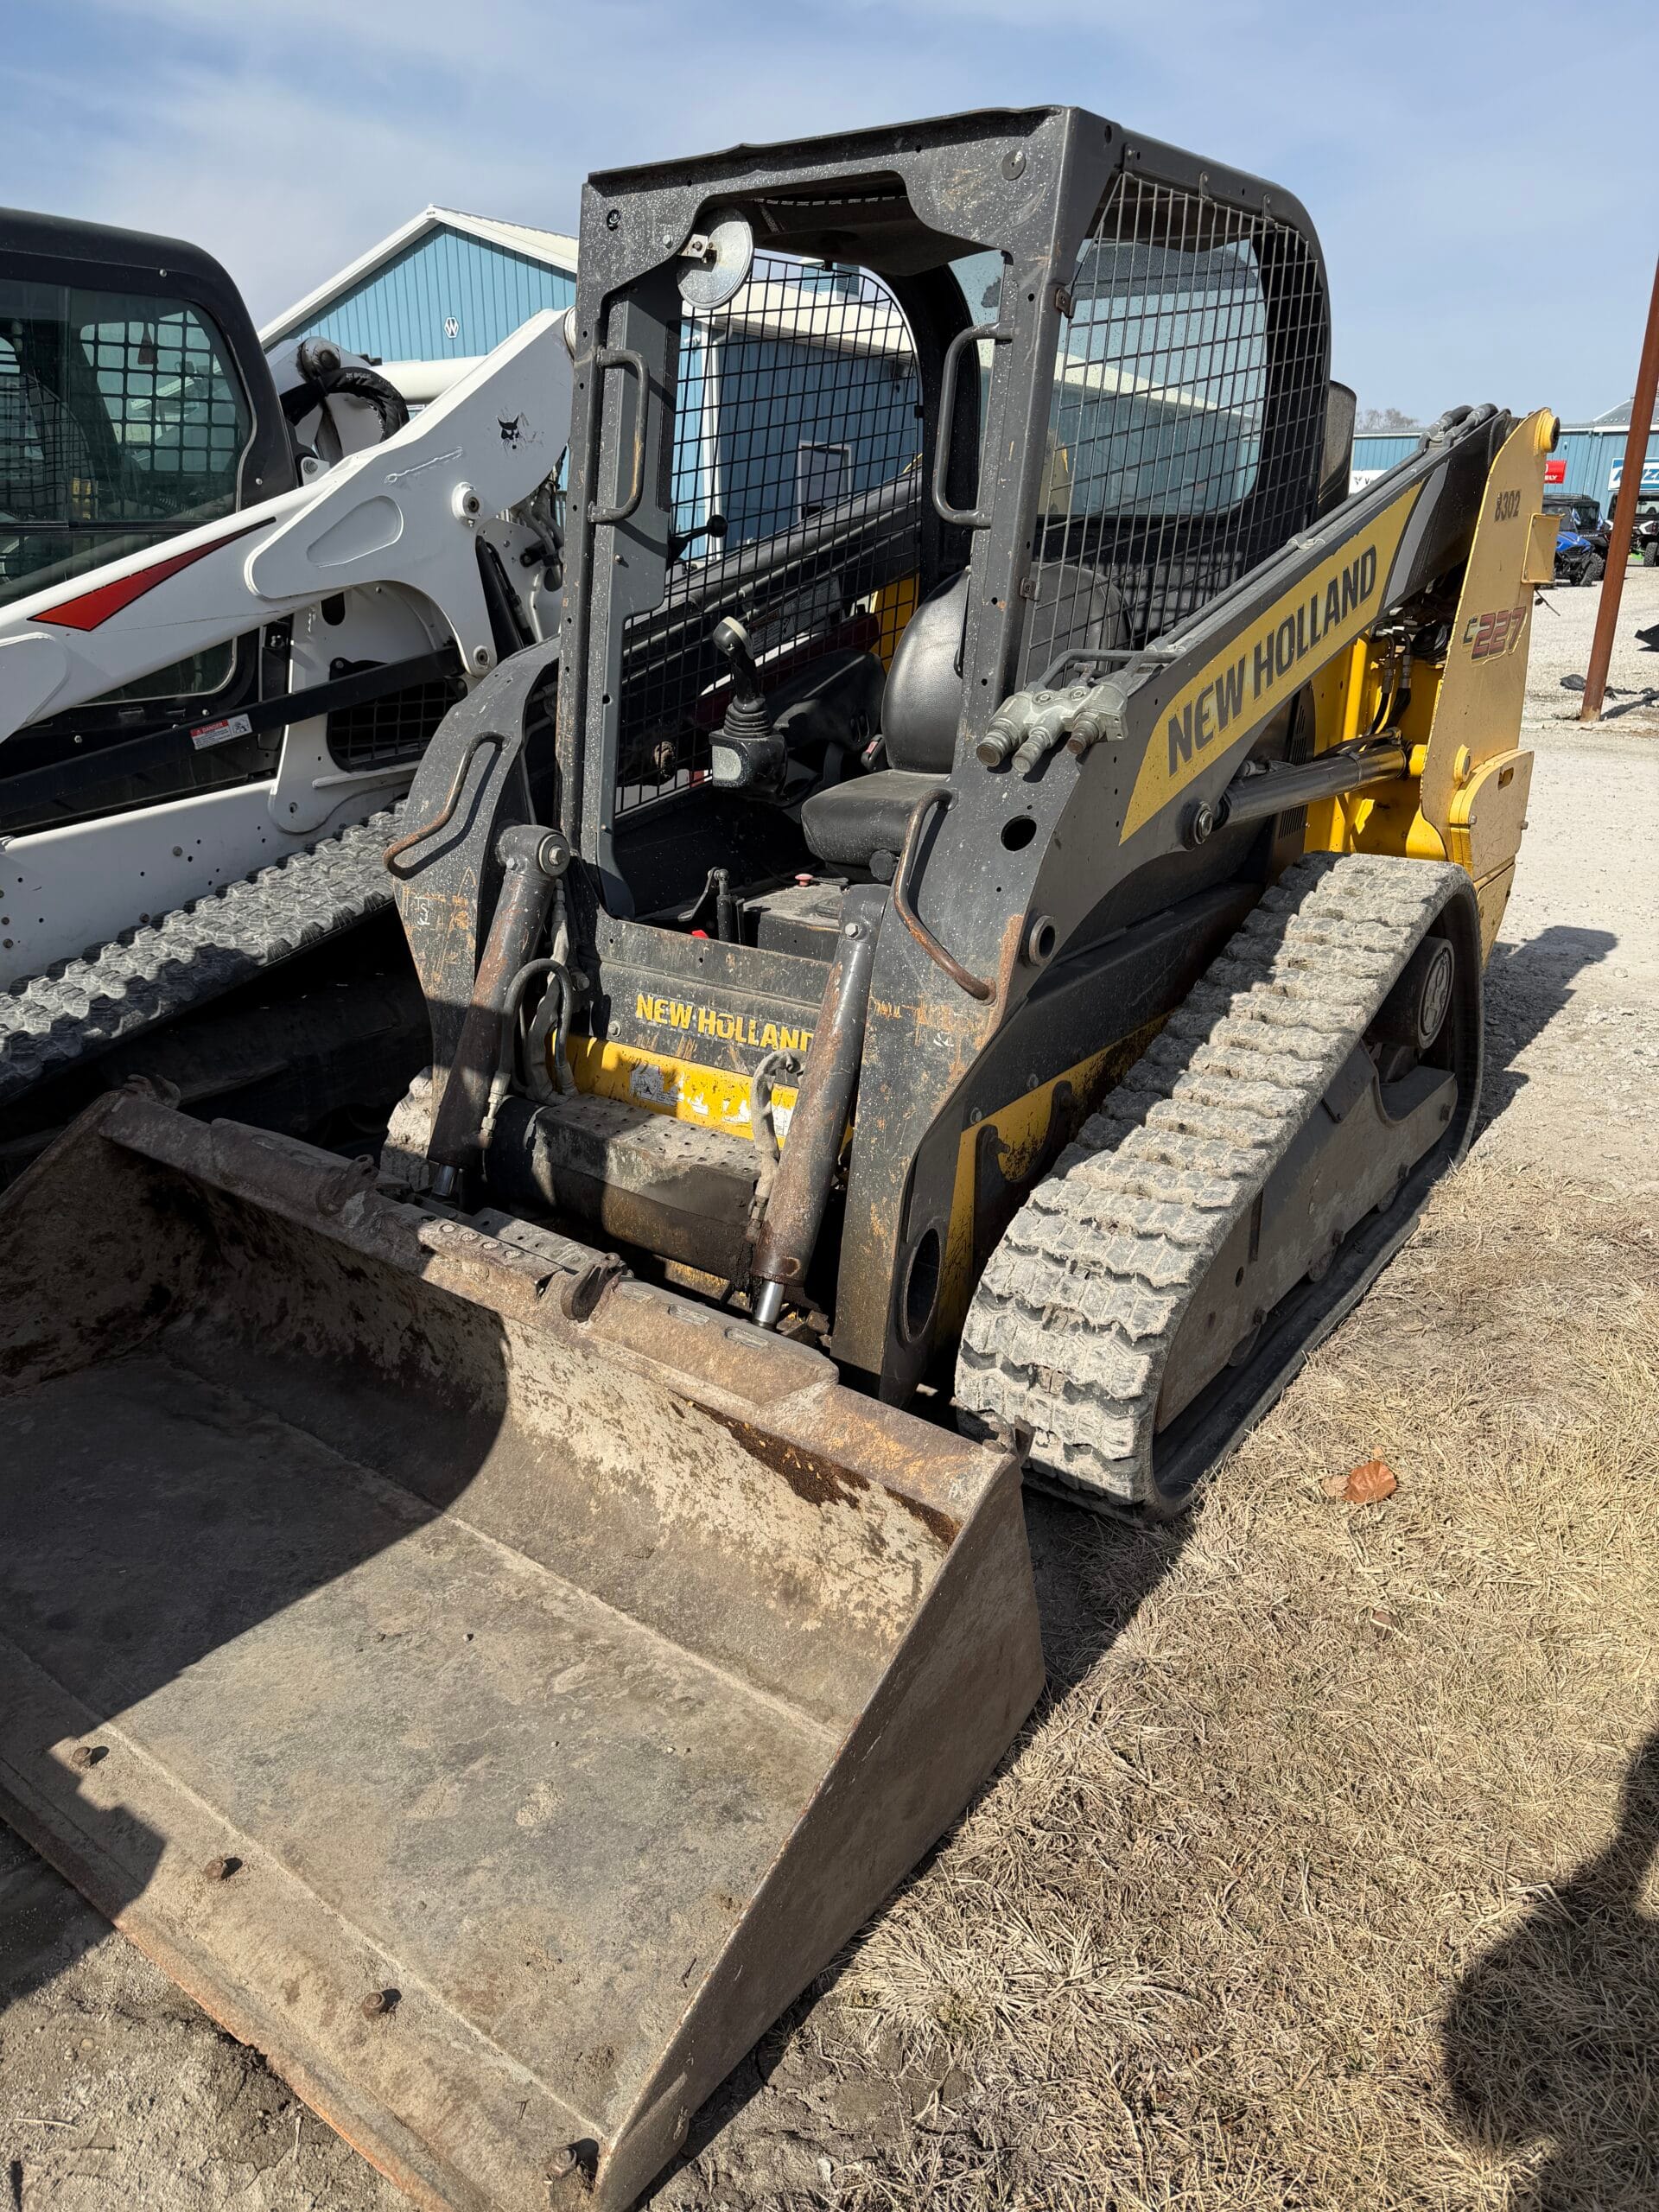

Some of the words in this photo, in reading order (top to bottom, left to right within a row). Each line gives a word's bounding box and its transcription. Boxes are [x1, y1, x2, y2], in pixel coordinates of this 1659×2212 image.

[1494, 490, 1521, 522] 8302
[1167, 656, 1247, 778] NEW
[1253, 544, 1377, 701] HOLLAND
[636, 994, 692, 1029] NEW
